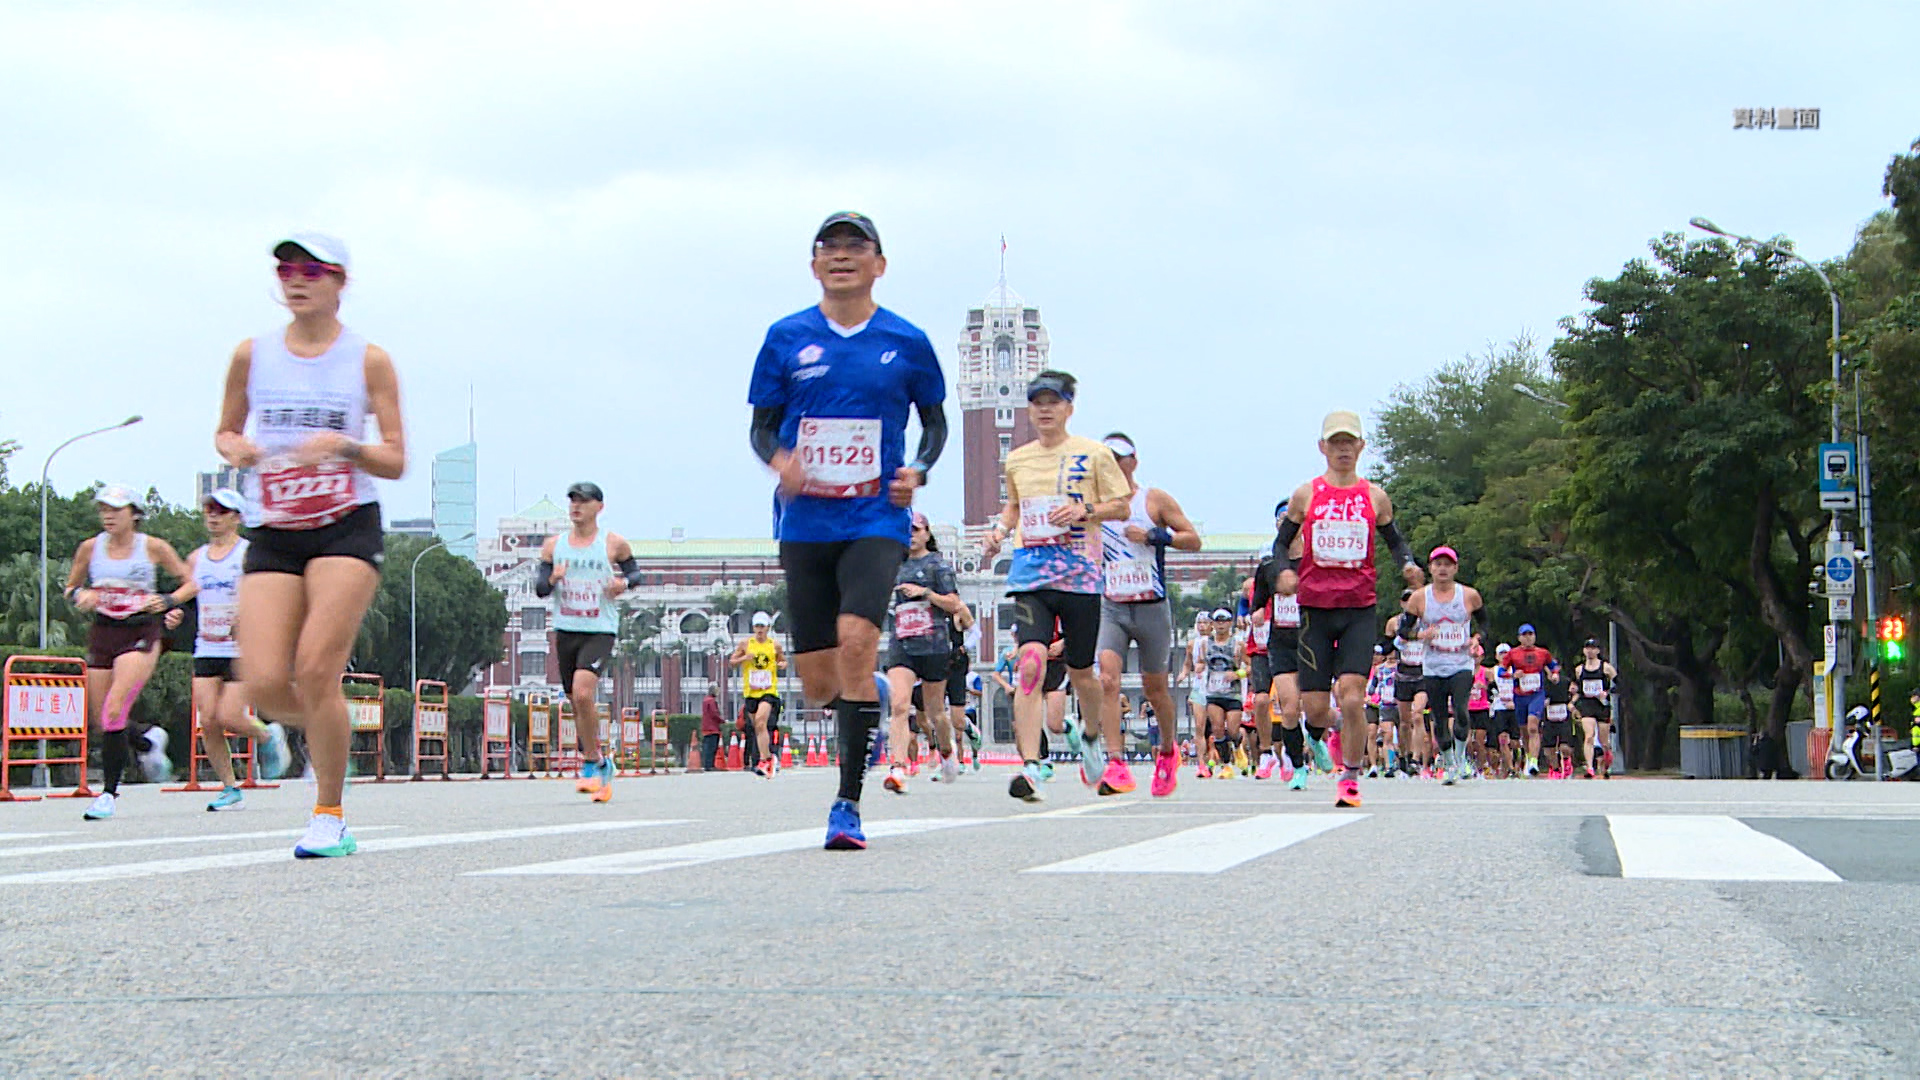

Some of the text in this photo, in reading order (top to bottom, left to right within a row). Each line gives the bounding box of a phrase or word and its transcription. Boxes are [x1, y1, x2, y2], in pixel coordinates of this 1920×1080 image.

[803, 445, 875, 466] 01529
[266, 473, 351, 503] 12227
[1317, 535, 1365, 550] 08575
[1882, 617, 1904, 639] 23
[19, 691, 77, 714] 禁止進入
